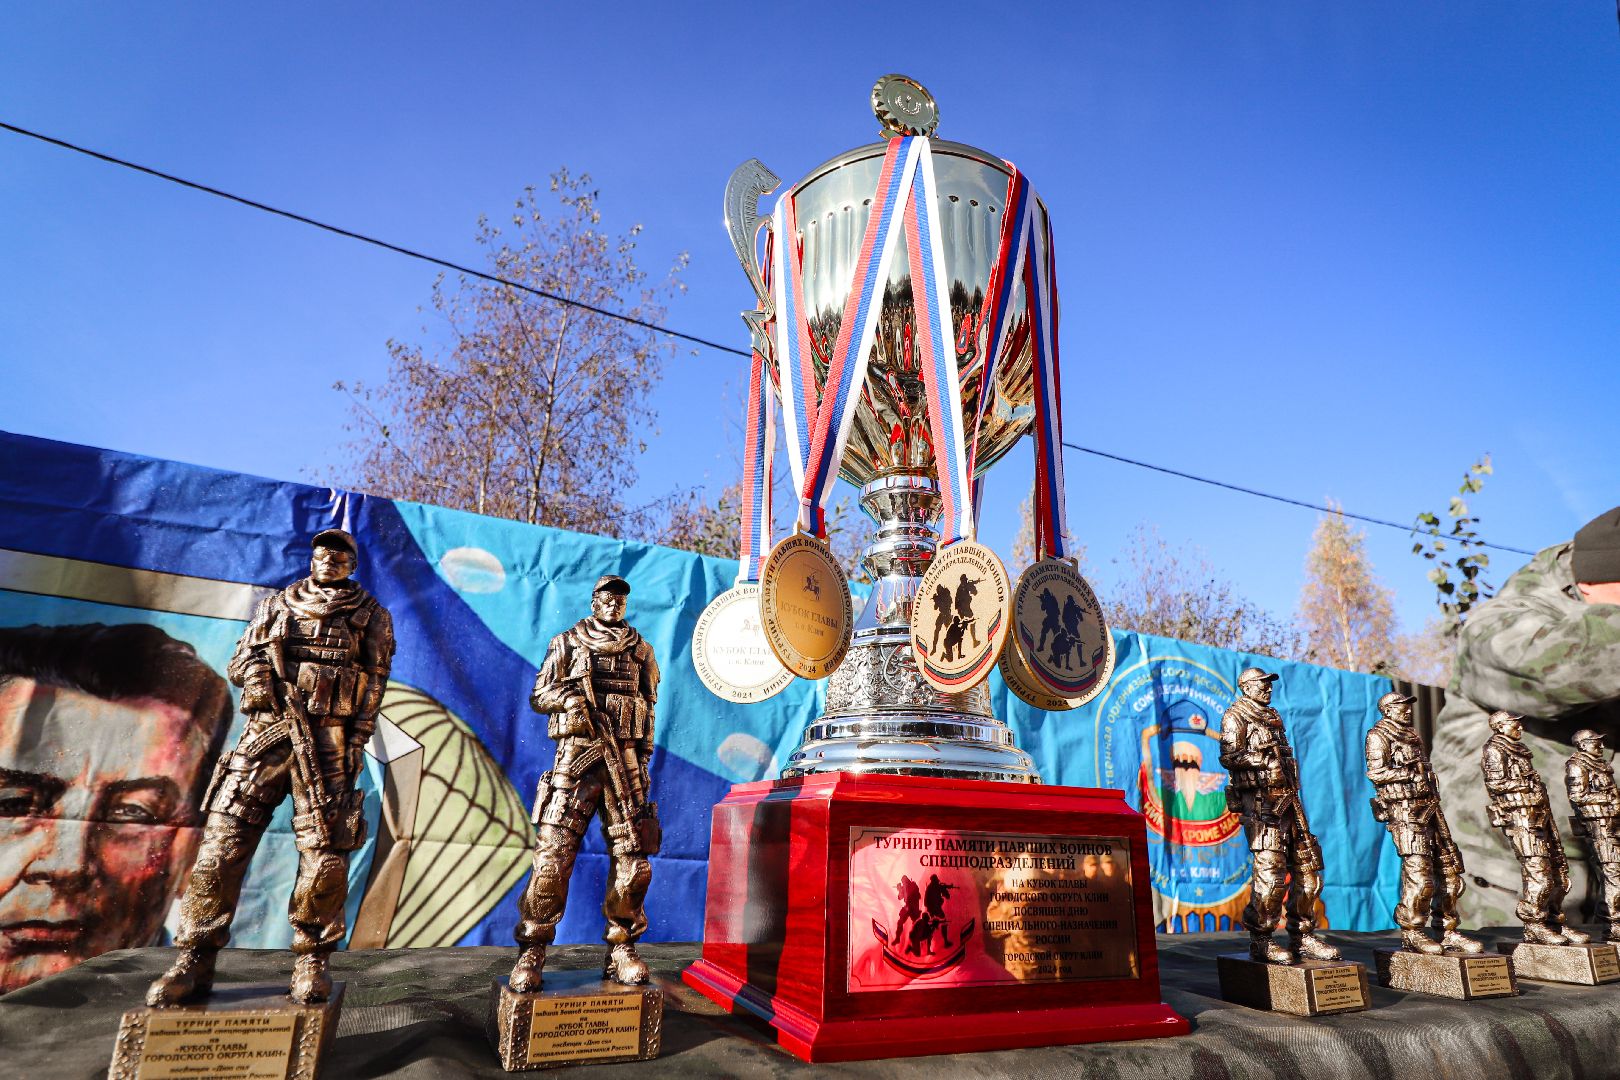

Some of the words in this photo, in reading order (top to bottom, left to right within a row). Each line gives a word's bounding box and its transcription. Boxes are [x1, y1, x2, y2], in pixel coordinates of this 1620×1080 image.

[773, 538, 803, 565] ПАВШИХ
[804, 539, 834, 564] ВОИНОВ
[953, 546, 987, 560] ПАВШИХ
[985, 558, 1004, 603] ВОИНОВ
[706, 589, 741, 617] ПАВШИХ
[799, 663, 817, 674] 2024
[732, 690, 753, 699] 2024
[1046, 699, 1069, 707] 2024
[874, 836, 932, 850] ТУРНИР
[936, 838, 996, 852] ПАМЯТИ
[998, 840, 1057, 855] ПАВШИХ
[1060, 842, 1112, 856] ВОИНОВ
[920, 854, 1076, 871] СПЕЦПОДРАЗДЕЛЕНИЙ
[1012, 879, 1025, 888] НА
[1027, 879, 1056, 889] КУБОК
[1058, 879, 1088, 889] ГЛАВЫ
[990, 892, 1048, 903] ГОРОДСКОГО
[1050, 892, 1082, 902] ОКРУГА
[1085, 892, 1109, 903] КЛИН
[1014, 906, 1065, 918] ПОСВЯЩЕН
[1067, 906, 1088, 918] ДНЮ
[1035, 934, 1072, 945] РОССИИ
[1003, 949, 1052, 963] ГОРОДСКОЙ
[554, 1001, 587, 1009] ТУРНИР
[590, 999, 624, 1007] ПАМЯТИ
[176, 1019, 220, 1028] ТУРНИР
[224, 1018, 270, 1027] ПАМЯТИ
[584, 1020, 609, 1028] ГЛАВЫ
[532, 1030, 585, 1039] ГОРОДСКОГО
[586, 1027, 614, 1036] ОКРУГА
[215, 1043, 248, 1052] ГЛАВЫ
[145, 1053, 214, 1062] ГОРОДСКОГО
[217, 1050, 254, 1060] ОКРУГА
